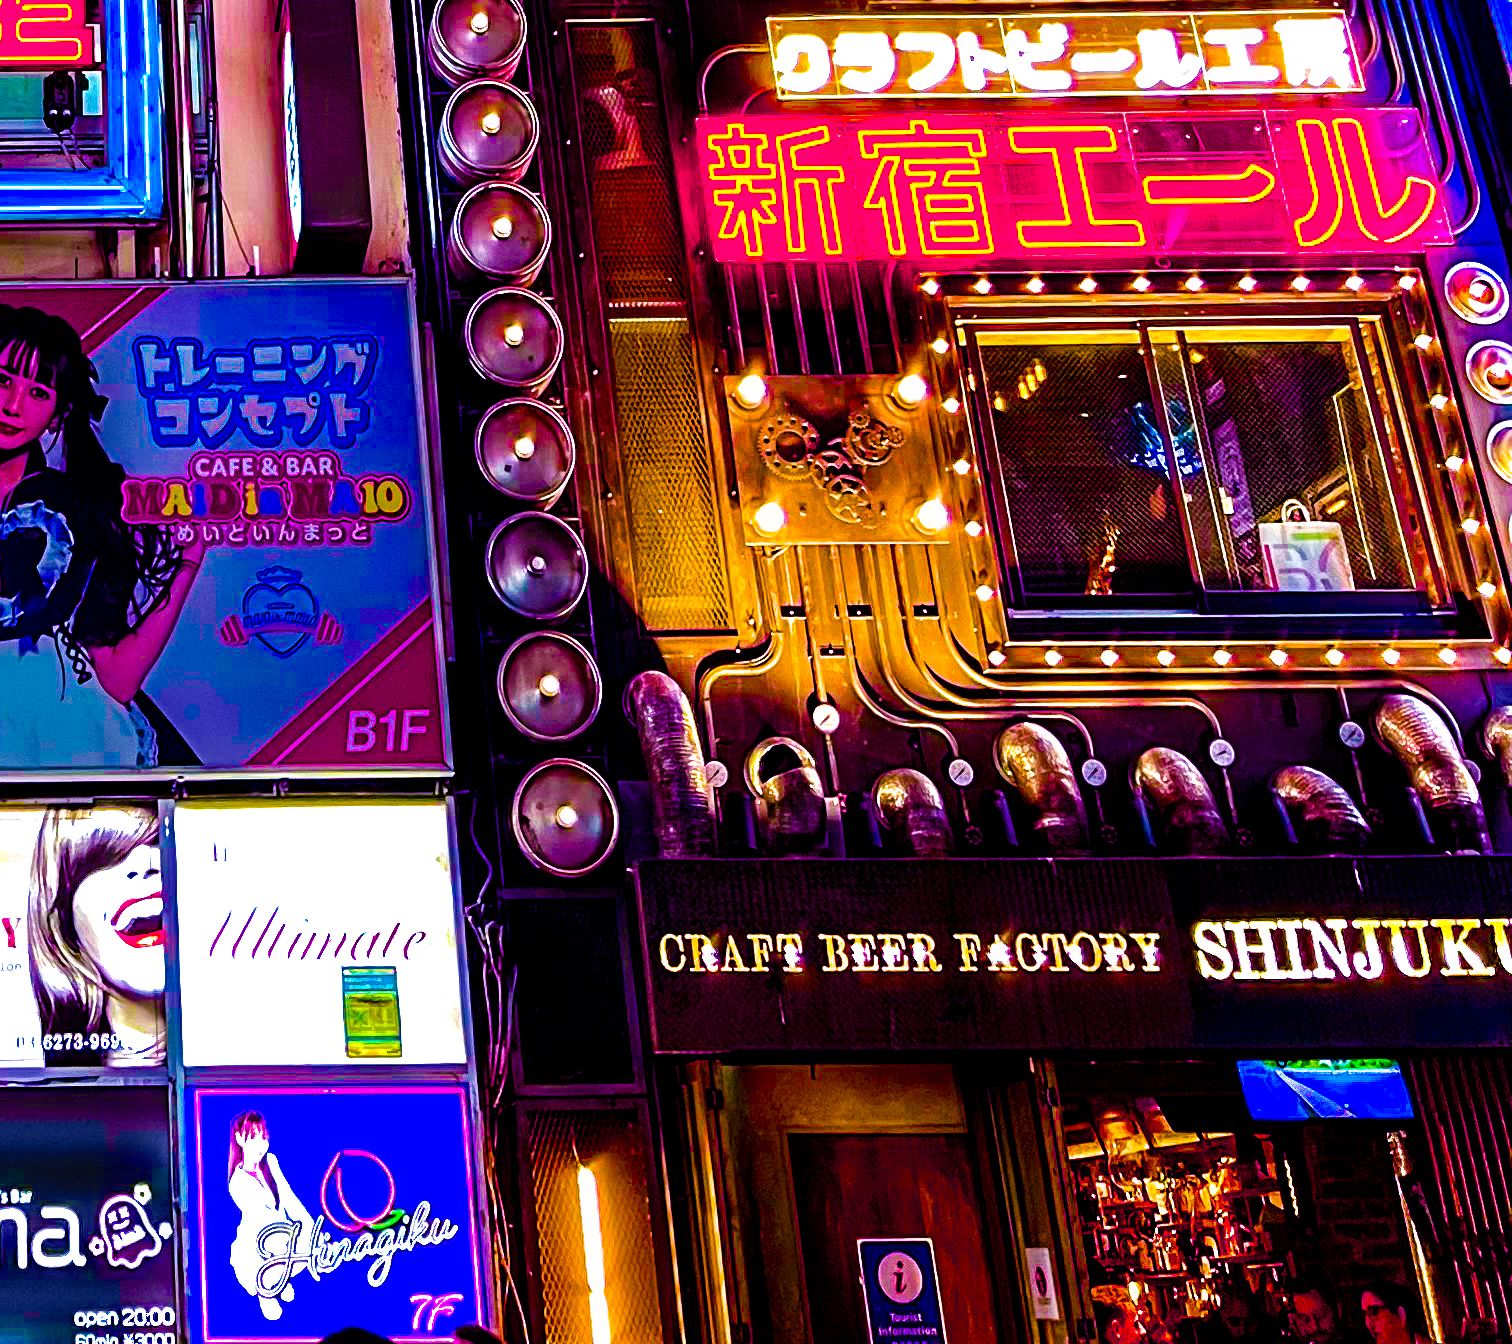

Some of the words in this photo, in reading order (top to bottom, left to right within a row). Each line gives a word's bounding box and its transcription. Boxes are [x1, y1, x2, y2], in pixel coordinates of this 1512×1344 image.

[707, 116, 1438, 257] 新宿エール
[138, 341, 370, 388] トレーニング
[154, 392, 361, 438] コンセプト
[195, 457, 254, 477] CAFE
[261, 457, 280, 477] &
[286, 456, 334, 476] BAR
[177, 523, 369, 543] めいといんまっと
[345, 709, 431, 754] B1F
[658, 932, 803, 973] CRAFT
[818, 932, 943, 973] BEER
[953, 932, 1162, 973] FACTORY
[255, 1200, 459, 1299] Hinagiku
[74, 1311, 119, 1328] open
[121, 1306, 176, 1327] 20:00
[410, 1293, 464, 1330] 7F
